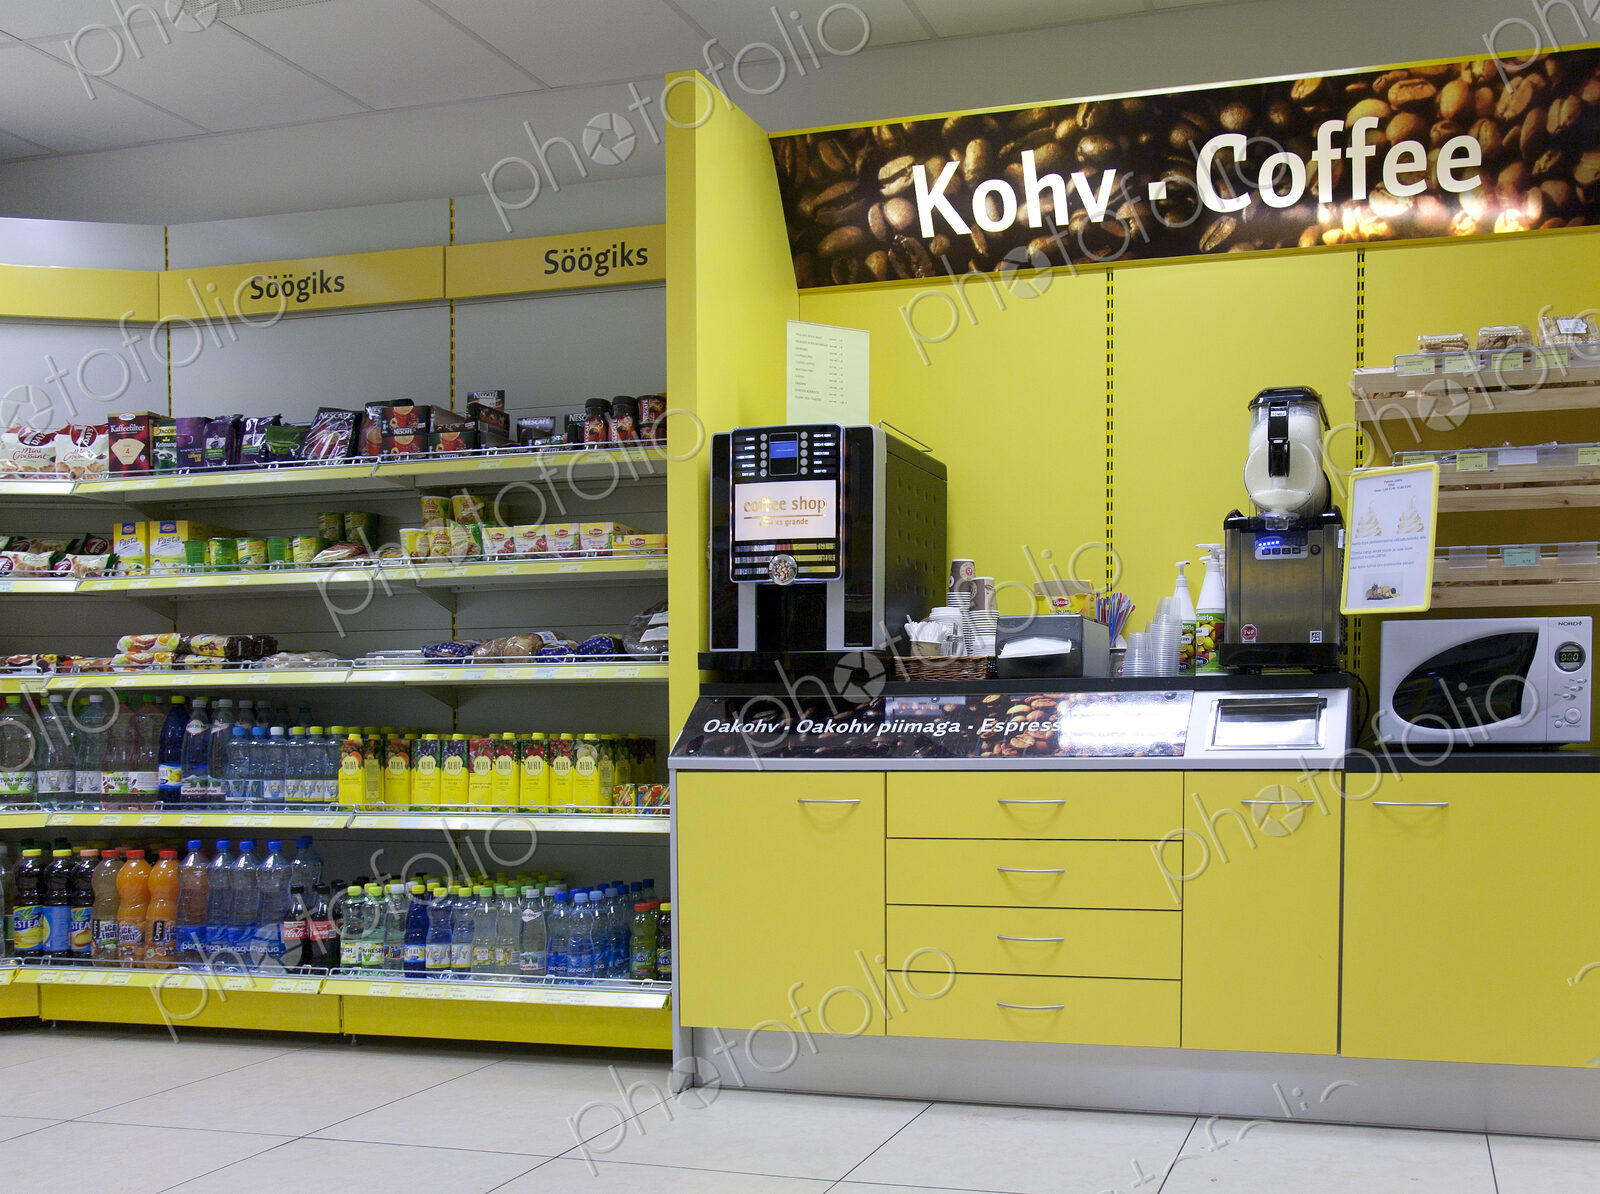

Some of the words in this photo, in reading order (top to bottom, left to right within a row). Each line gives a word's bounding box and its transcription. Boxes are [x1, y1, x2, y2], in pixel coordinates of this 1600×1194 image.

[912, 149, 1117, 239] Kohv
[1196, 115, 1483, 213] Coffee
[543, 241, 649, 277] Söögiks
[250, 269, 345, 302] Söögiks
[110, 423, 145, 433] Kaffeefilter
[743, 497, 787, 513] coffee
[791, 495, 826, 513] shop
[784, 518, 809, 527] grande
[157, 535, 181, 545] Pasta
[703, 718, 780, 734] Oakohv
[796, 718, 873, 735] Oakohv
[876, 717, 961, 737] piimaga
[980, 717, 1063, 736] Espress
